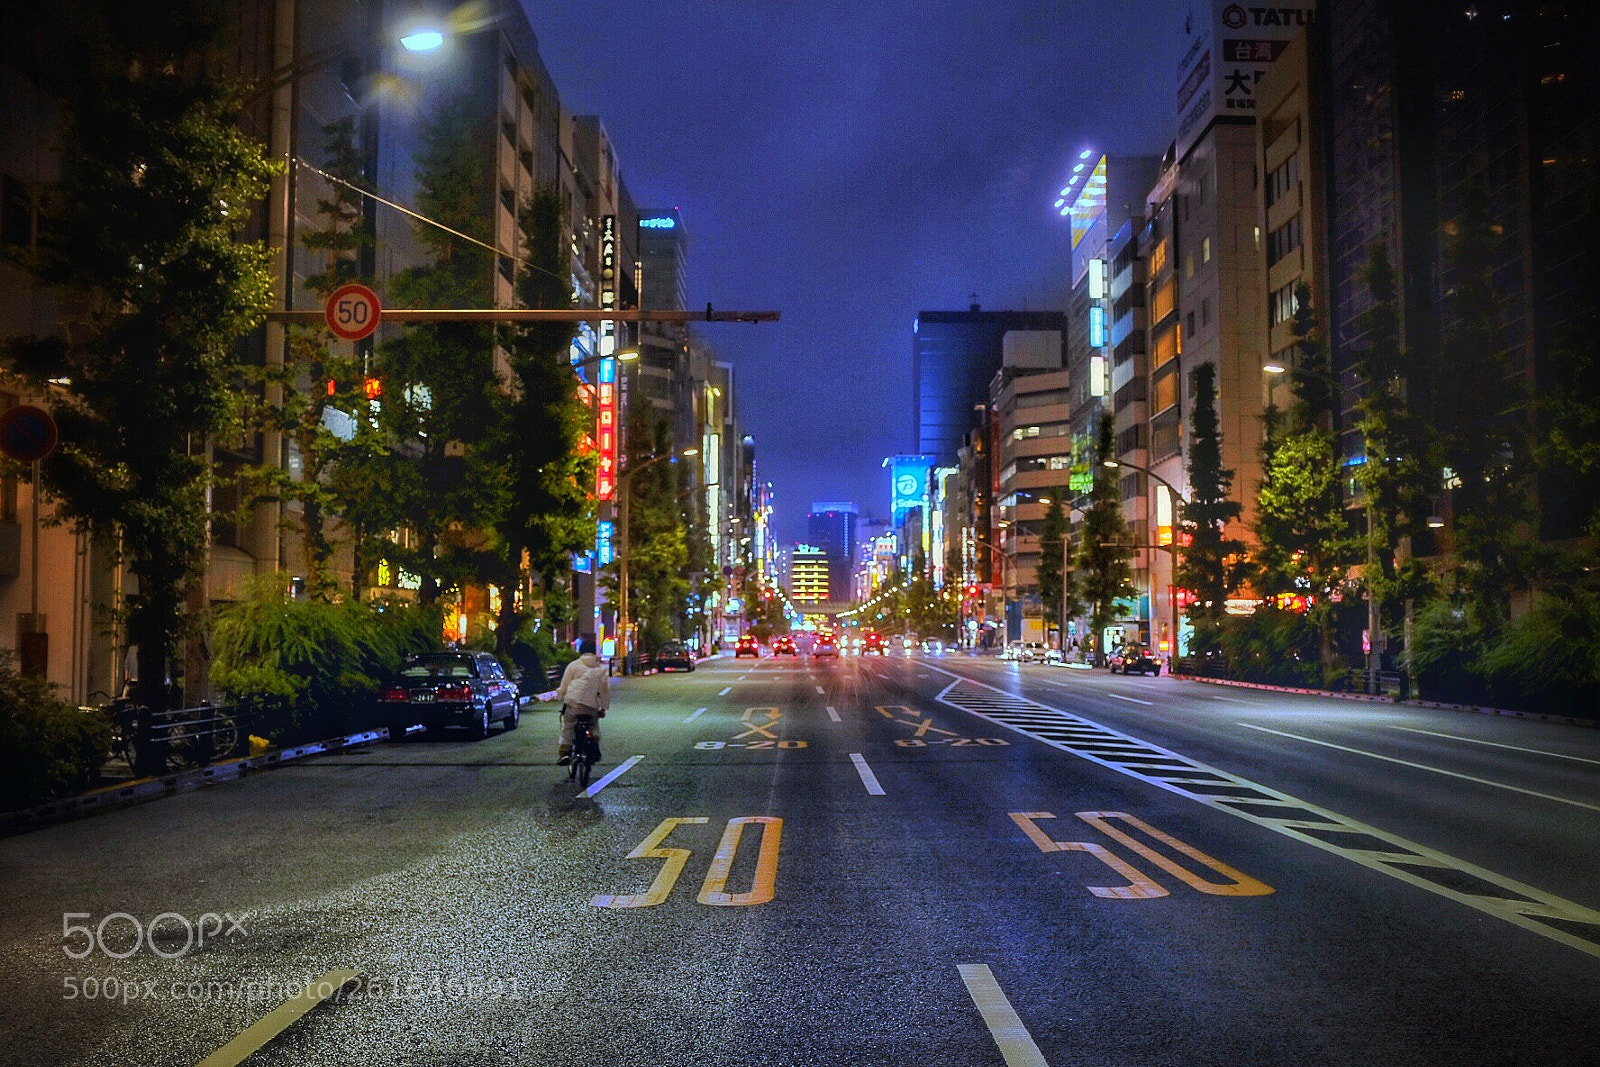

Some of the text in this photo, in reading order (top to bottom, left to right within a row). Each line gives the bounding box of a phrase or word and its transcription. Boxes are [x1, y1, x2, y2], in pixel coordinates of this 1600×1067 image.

[1247, 8, 1316, 27] TATU
[1225, 69, 1265, 95] 大
[338, 300, 368, 324] 50
[693, 740, 809, 750] 8-20
[894, 738, 1012, 748] 8-20
[588, 815, 783, 907] 50
[1007, 810, 1276, 899] 50
